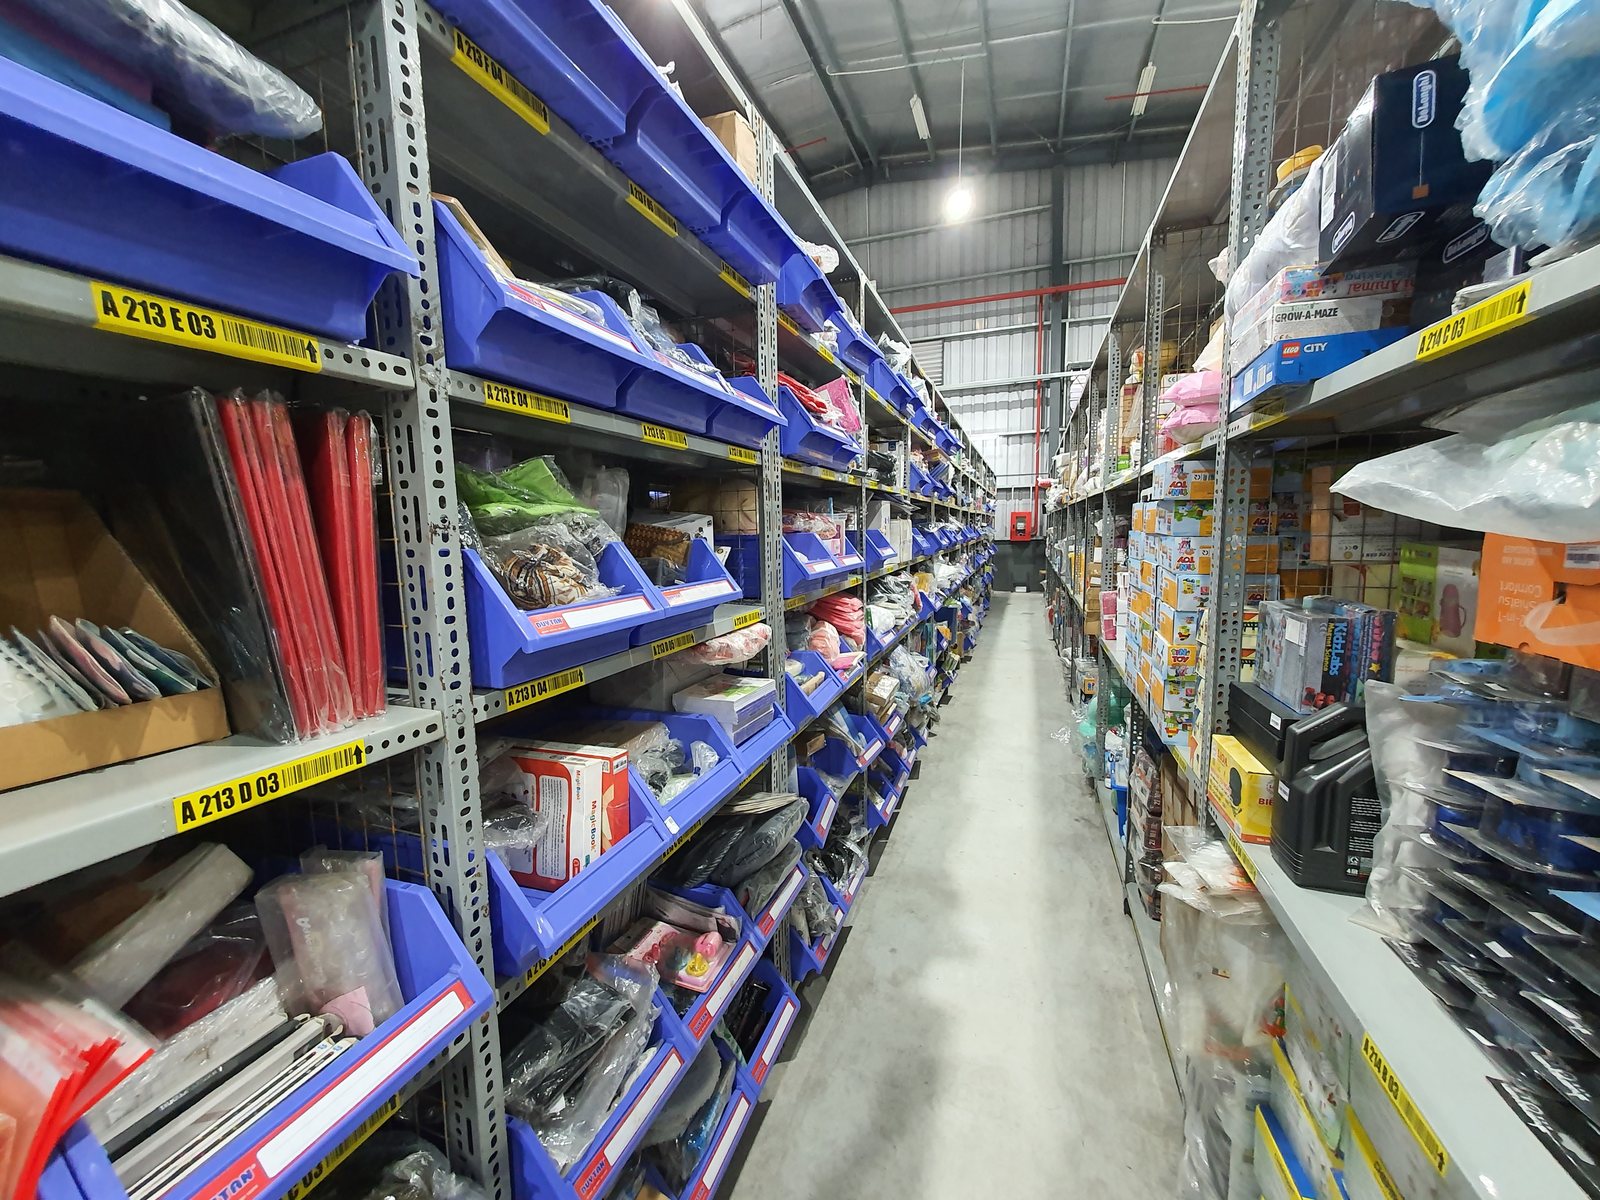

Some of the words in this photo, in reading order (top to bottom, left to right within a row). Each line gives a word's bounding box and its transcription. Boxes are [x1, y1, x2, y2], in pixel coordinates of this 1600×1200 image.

[457, 32, 464, 53] A
[465, 40, 483, 68] 213
[484, 55, 489, 73] F
[491, 61, 503, 85] 04
[101, 290, 119, 318] A
[122, 295, 166, 328] 213
[169, 307, 185, 332] E
[187, 311, 216, 339] 03
[1275, 307, 1338, 322] GROW-A-MAZE
[1283, 346, 1299, 354] LEGO
[1303, 342, 1328, 353] CITY
[1418, 336, 1426, 355] A
[1426, 327, 1442, 352] 214
[1443, 324, 1450, 344] C
[1451, 316, 1465, 340] 03
[487, 384, 494, 400] A
[494, 386, 510, 404] 213
[511, 390, 516, 405] E
[517, 392, 528, 408] 04
[1329, 622, 1348, 676] KidzLabs
[508, 691, 514, 706] A
[515, 686, 529, 703] 213
[530, 684, 536, 698] D
[537, 680, 547, 696] 04
[182, 800, 196, 824] A
[199, 787, 235, 818] 213
[239, 782, 253, 804] D
[256, 772, 280, 797] 03
[1364, 1038, 1369, 1055] A
[1369, 1045, 1382, 1073] 214
[1382, 1064, 1388, 1083] B
[1388, 1075, 1399, 1100] 03
